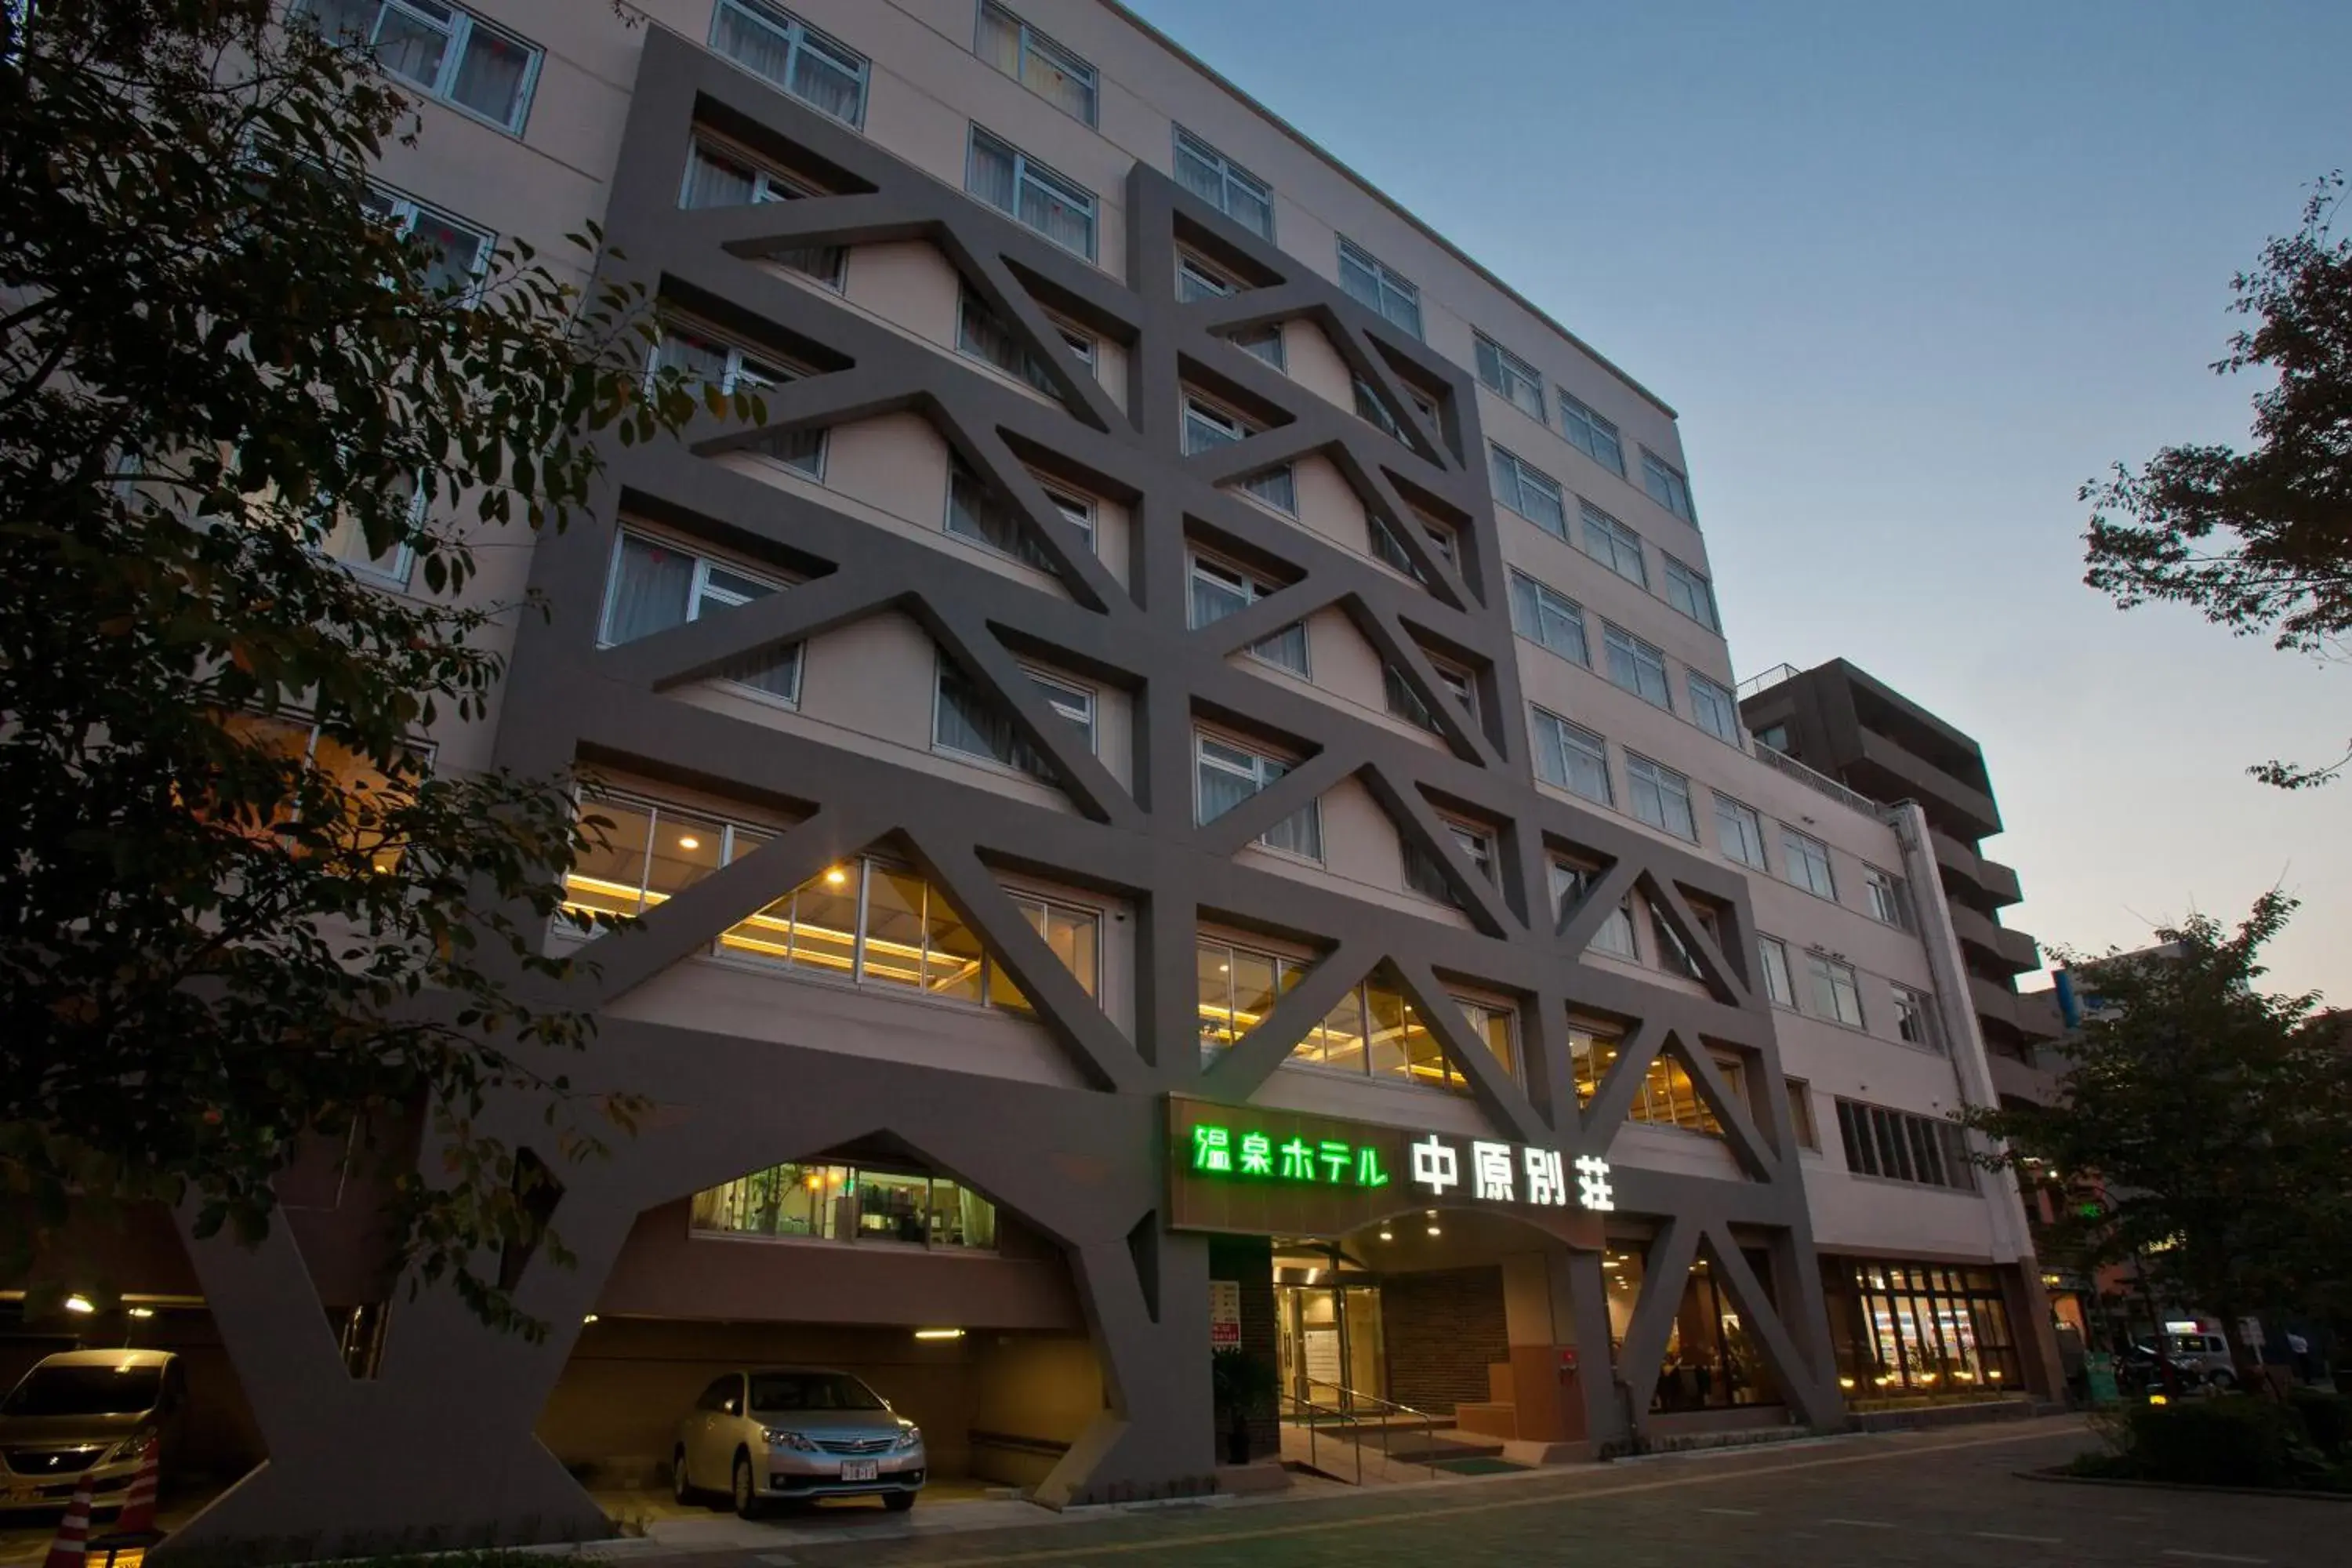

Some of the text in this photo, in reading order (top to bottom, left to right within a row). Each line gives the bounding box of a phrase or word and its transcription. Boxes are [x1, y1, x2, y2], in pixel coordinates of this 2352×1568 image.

[1192, 1124, 1614, 1211] 温泉ホテル 中原別荘
